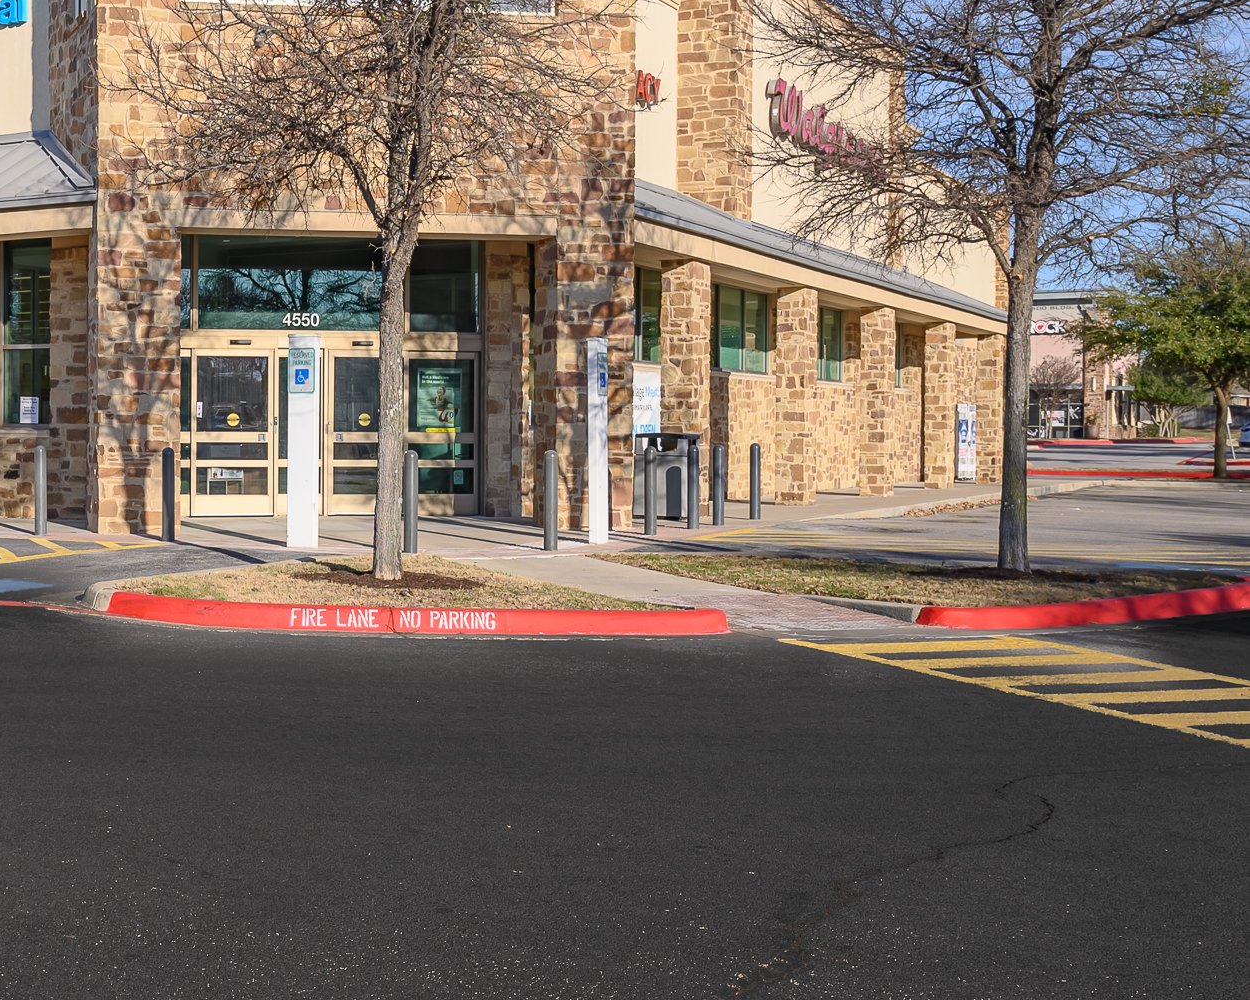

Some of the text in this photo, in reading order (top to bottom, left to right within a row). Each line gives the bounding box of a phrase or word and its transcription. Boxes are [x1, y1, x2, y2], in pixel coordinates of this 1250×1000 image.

[282, 312, 320, 327] 4550
[290, 607, 496, 630] FIRE LANE NO PARKING
